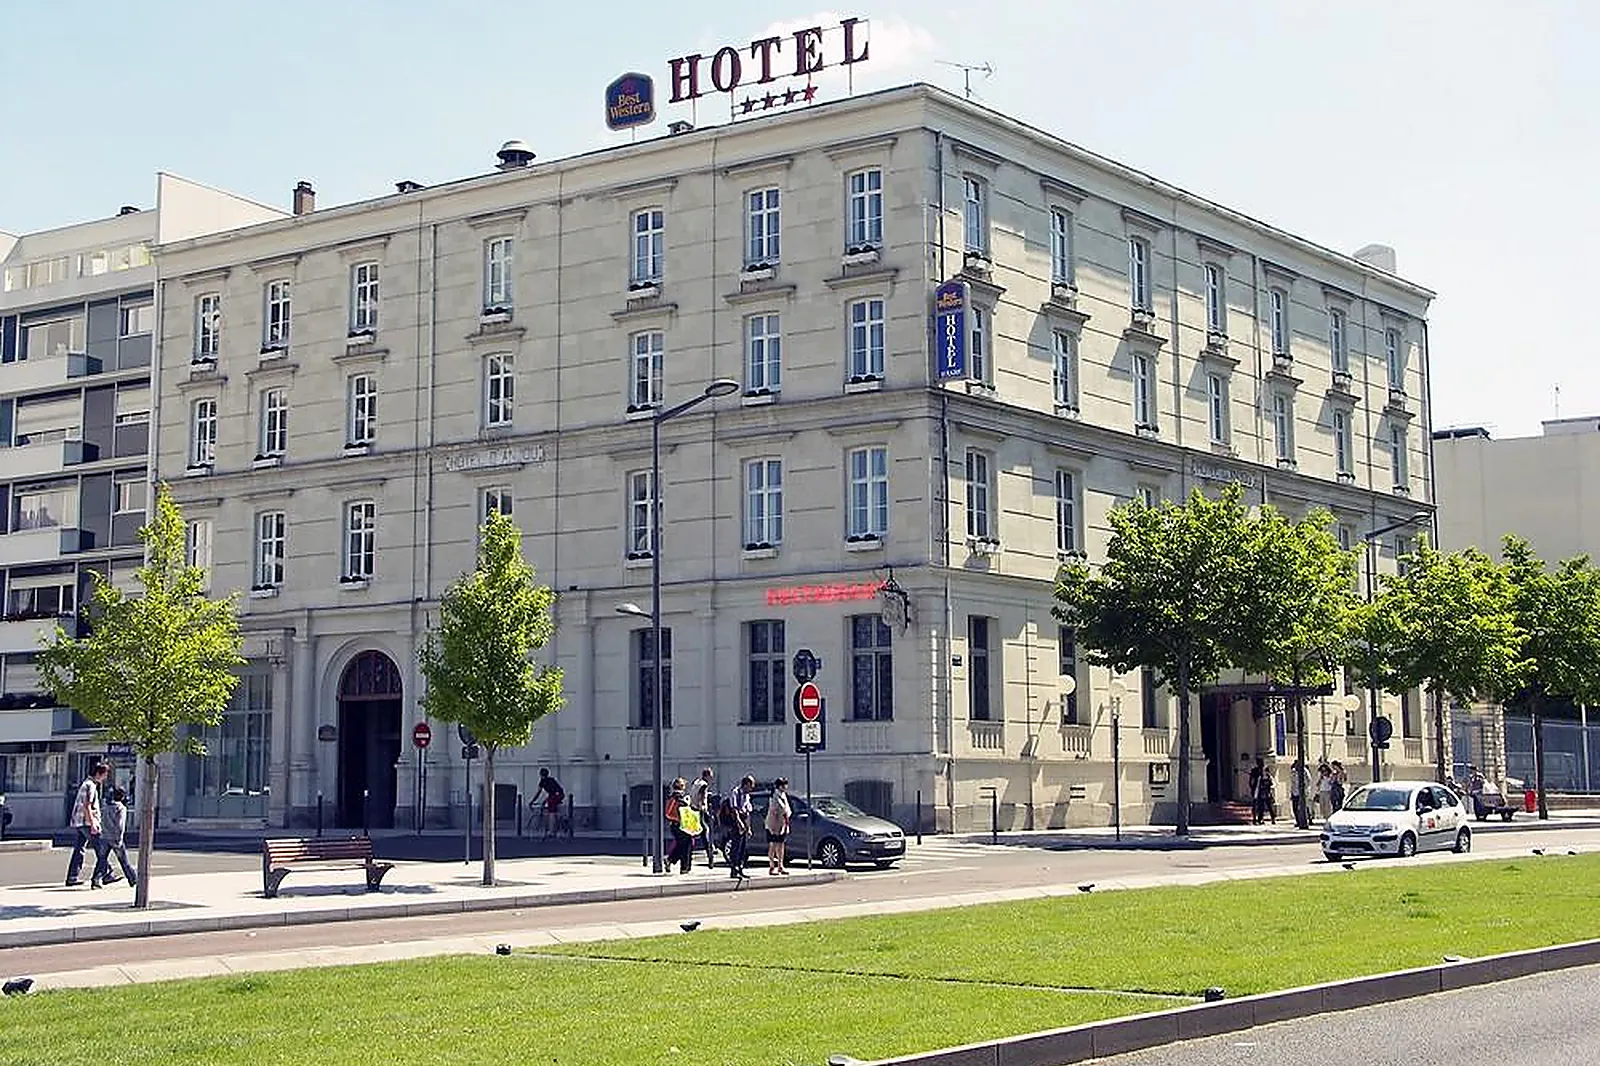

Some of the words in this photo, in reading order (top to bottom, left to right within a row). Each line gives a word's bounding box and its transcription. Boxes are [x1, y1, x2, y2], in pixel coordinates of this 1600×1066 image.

[668, 17, 869, 103] HOTEL
[610, 102, 650, 119] Western
[618, 93, 641, 107] Best
[946, 314, 956, 368] HOTEL
